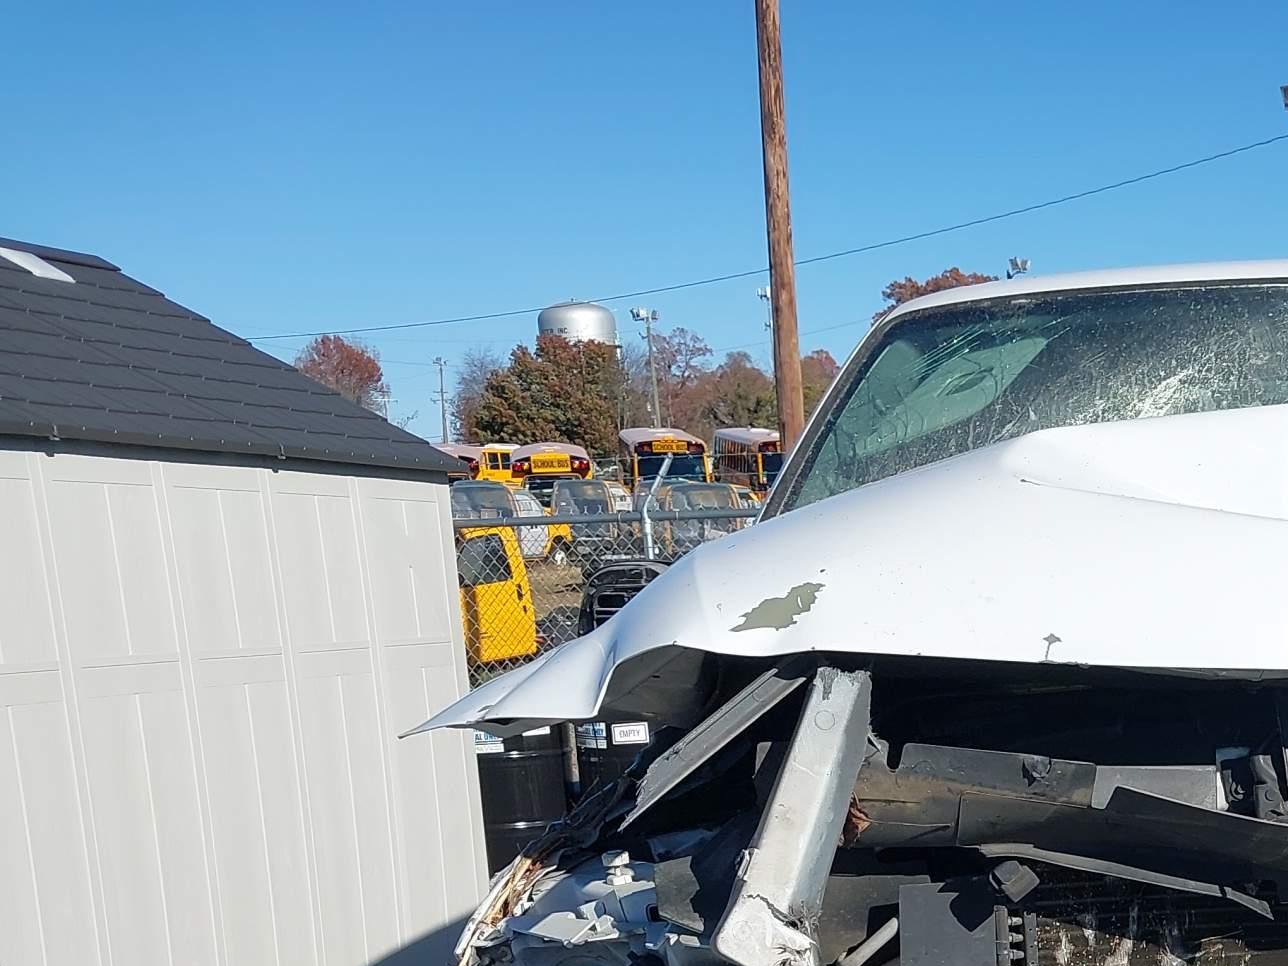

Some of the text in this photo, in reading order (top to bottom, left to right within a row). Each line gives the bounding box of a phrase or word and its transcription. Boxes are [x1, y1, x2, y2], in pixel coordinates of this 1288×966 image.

[653, 443, 675, 451] SCHOOL
[532, 458, 569, 469] SCHOOL BUS
[619, 728, 641, 738] EMPTY
